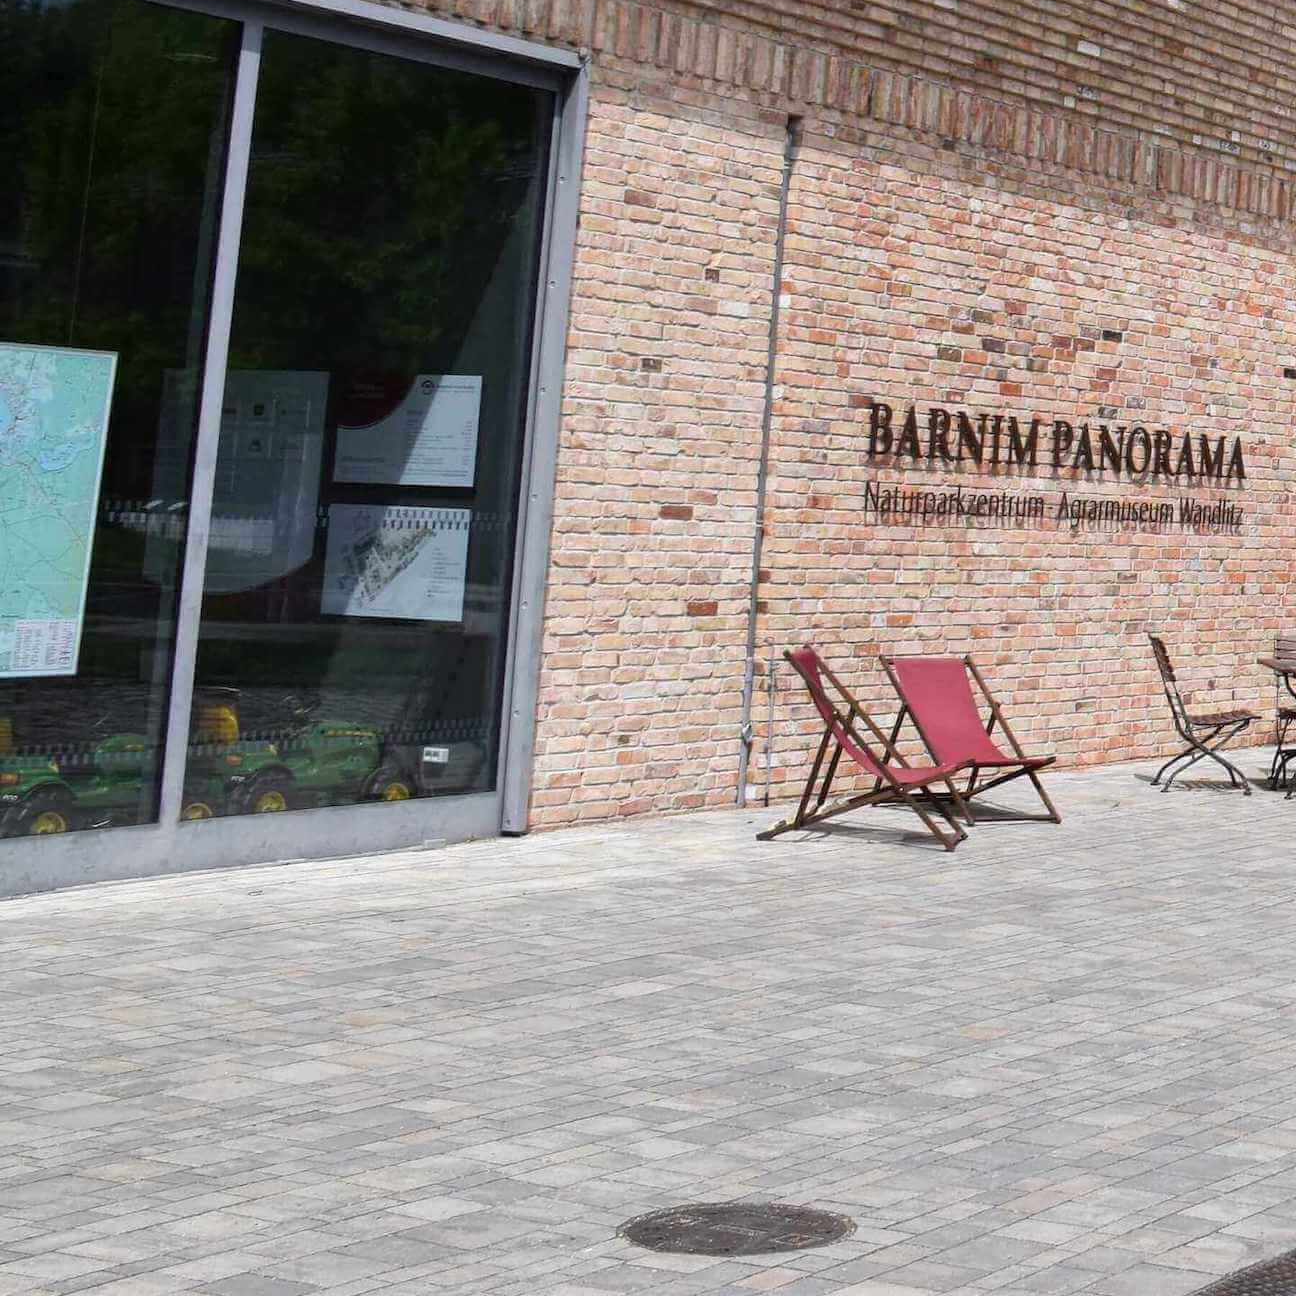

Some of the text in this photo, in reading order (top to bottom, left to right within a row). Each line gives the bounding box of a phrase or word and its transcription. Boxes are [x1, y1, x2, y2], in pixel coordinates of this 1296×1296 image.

[868, 403, 1246, 478] BARNIM PANORAMA
[864, 480, 1044, 522] Naturparkzentrum
[1057, 492, 1174, 526] Agrarmuseum
[1179, 497, 1243, 525] Wandlitz
